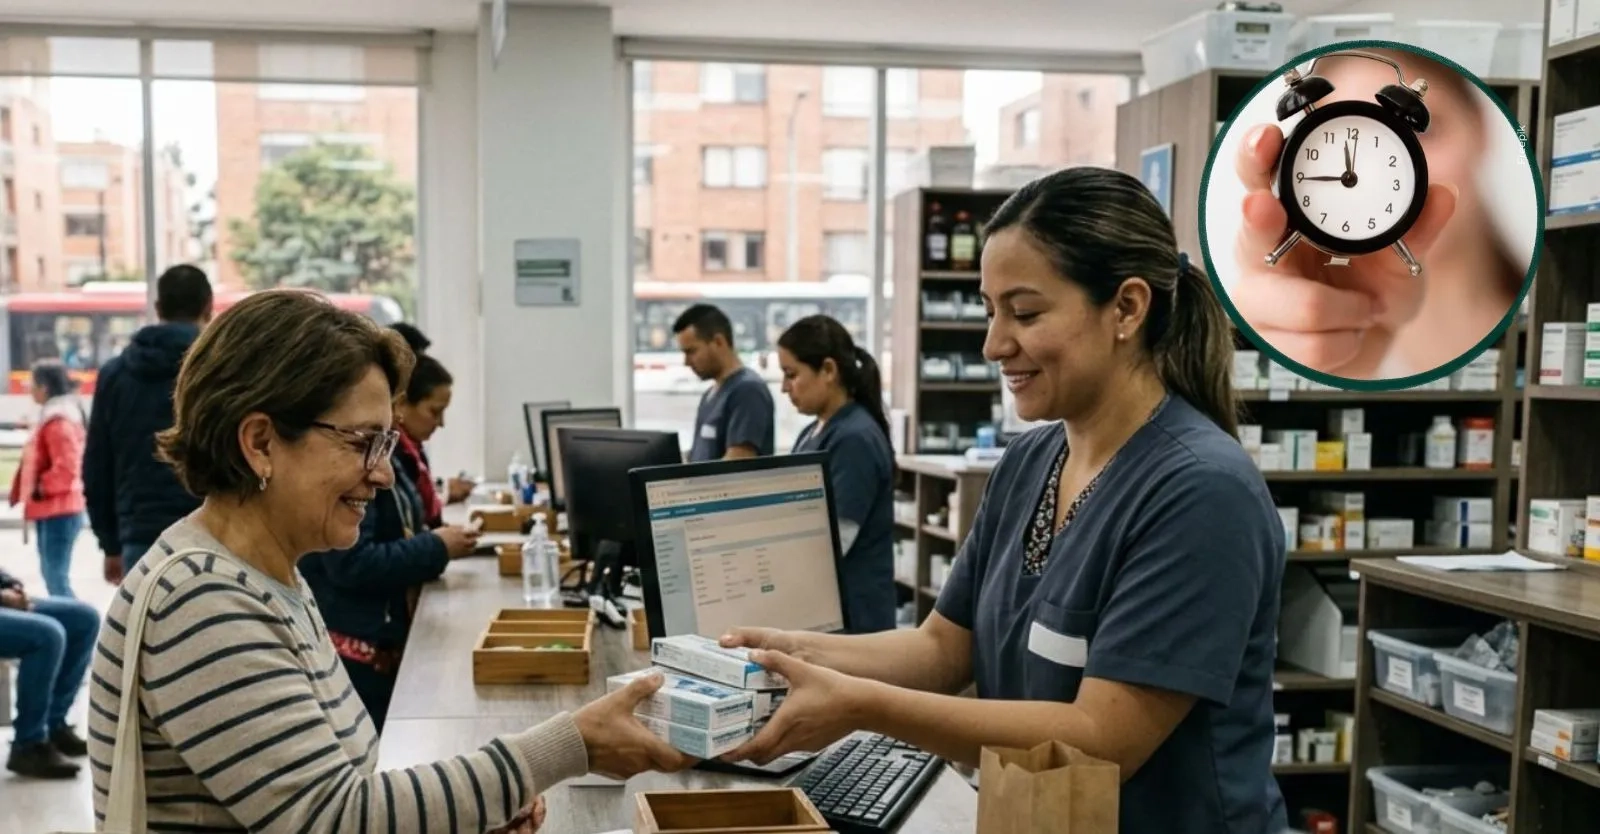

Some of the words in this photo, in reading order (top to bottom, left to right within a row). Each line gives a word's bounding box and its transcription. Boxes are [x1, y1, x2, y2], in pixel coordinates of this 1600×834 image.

[1323, 131, 1335, 145] 11
[1346, 127, 1359, 141] 12
[1374, 136, 1379, 148] 1
[1305, 148, 1319, 161] 10
[1388, 155, 1397, 168] 2
[1296, 171, 1305, 184] 9
[1392, 179, 1401, 192] 3
[1302, 195, 1311, 208] 8
[1384, 202, 1393, 214] 4
[1320, 212, 1328, 225] 7
[1367, 217, 1376, 230] 5
[1341, 220, 1350, 233] 6
